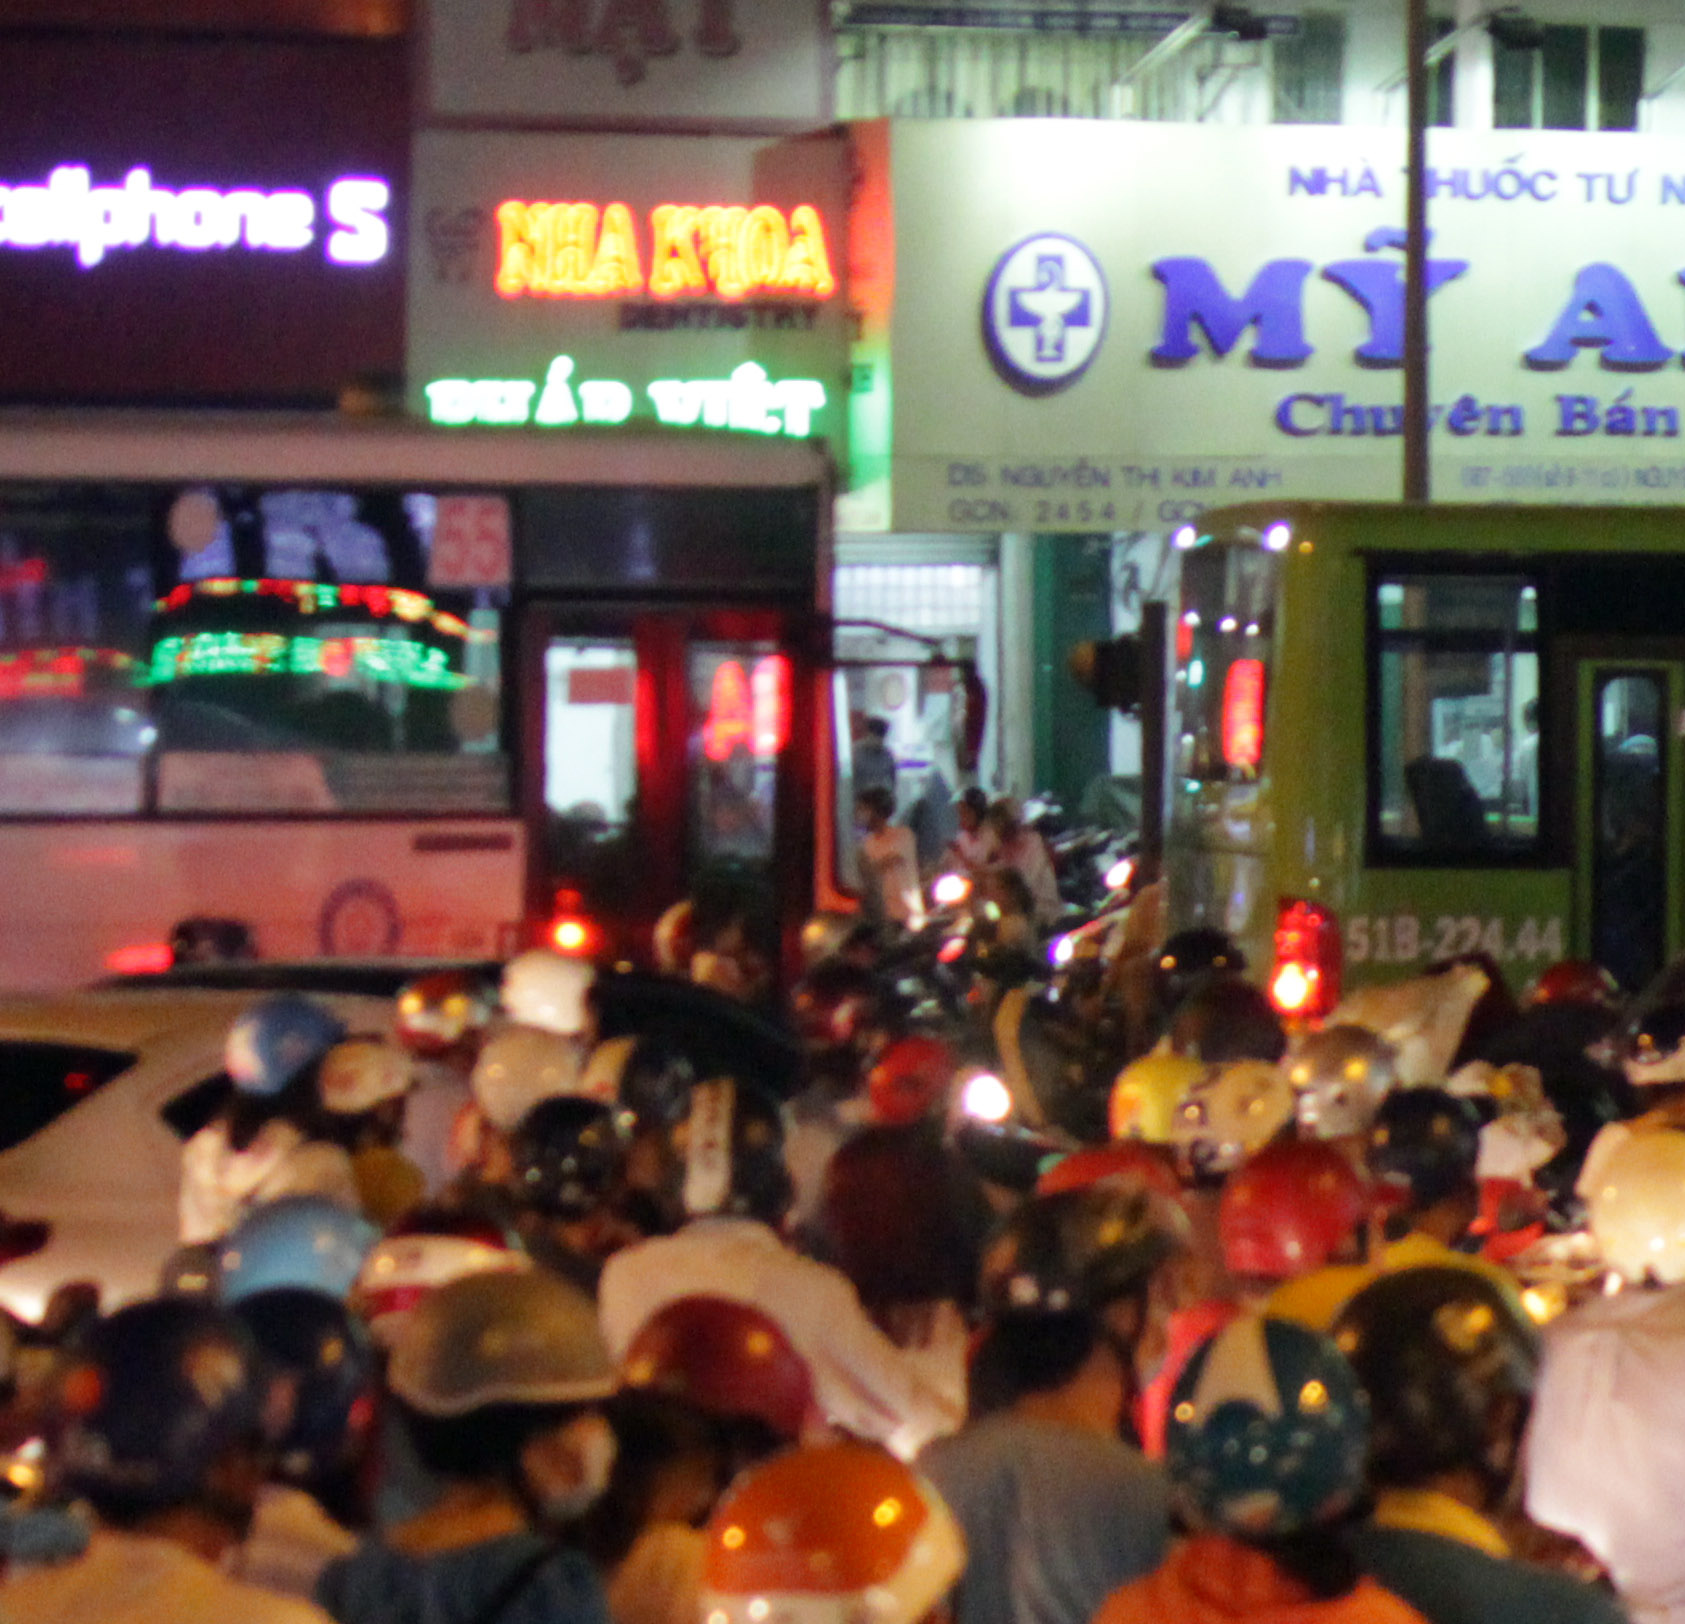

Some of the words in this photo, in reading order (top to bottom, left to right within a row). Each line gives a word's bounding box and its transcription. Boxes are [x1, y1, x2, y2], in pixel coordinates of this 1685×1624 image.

[1402, 152, 1559, 203] HUỐC
[0, 165, 314, 269] ellphone
[1555, 386, 1681, 438] Bán
